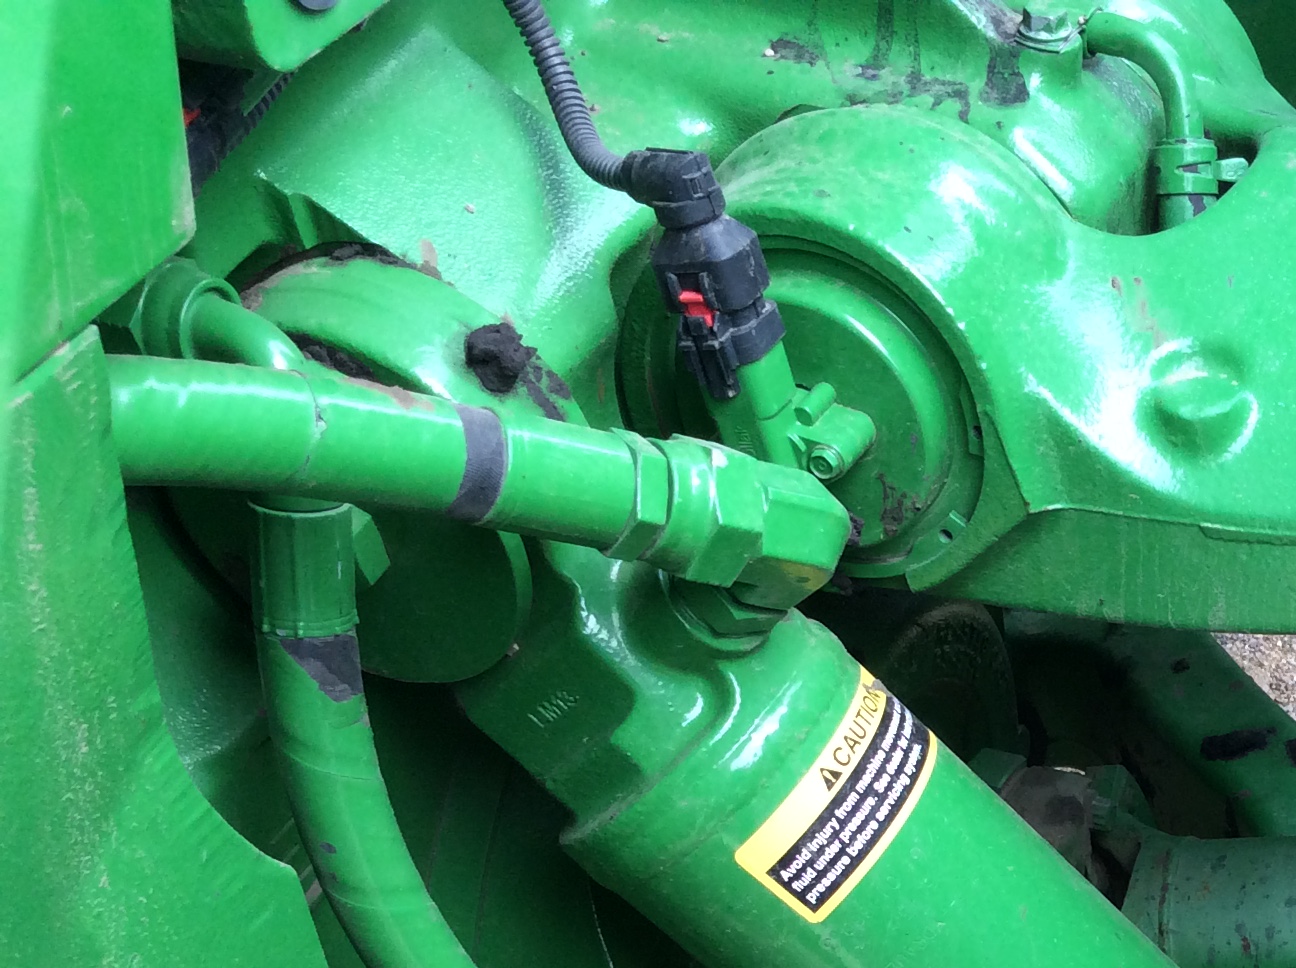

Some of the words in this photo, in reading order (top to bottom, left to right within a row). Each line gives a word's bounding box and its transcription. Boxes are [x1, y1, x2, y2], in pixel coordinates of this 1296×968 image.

[780, 848, 812, 882] Avoid
[806, 817, 840, 851] injury
[833, 791, 860, 820] from
[855, 749, 886, 794] machine
[791, 867, 817, 892] fluid
[813, 838, 842, 871] under
[873, 773, 891, 793] See
[805, 855, 851, 905] pressure
[845, 820, 879, 857] before
[875, 773, 911, 822] servicing
